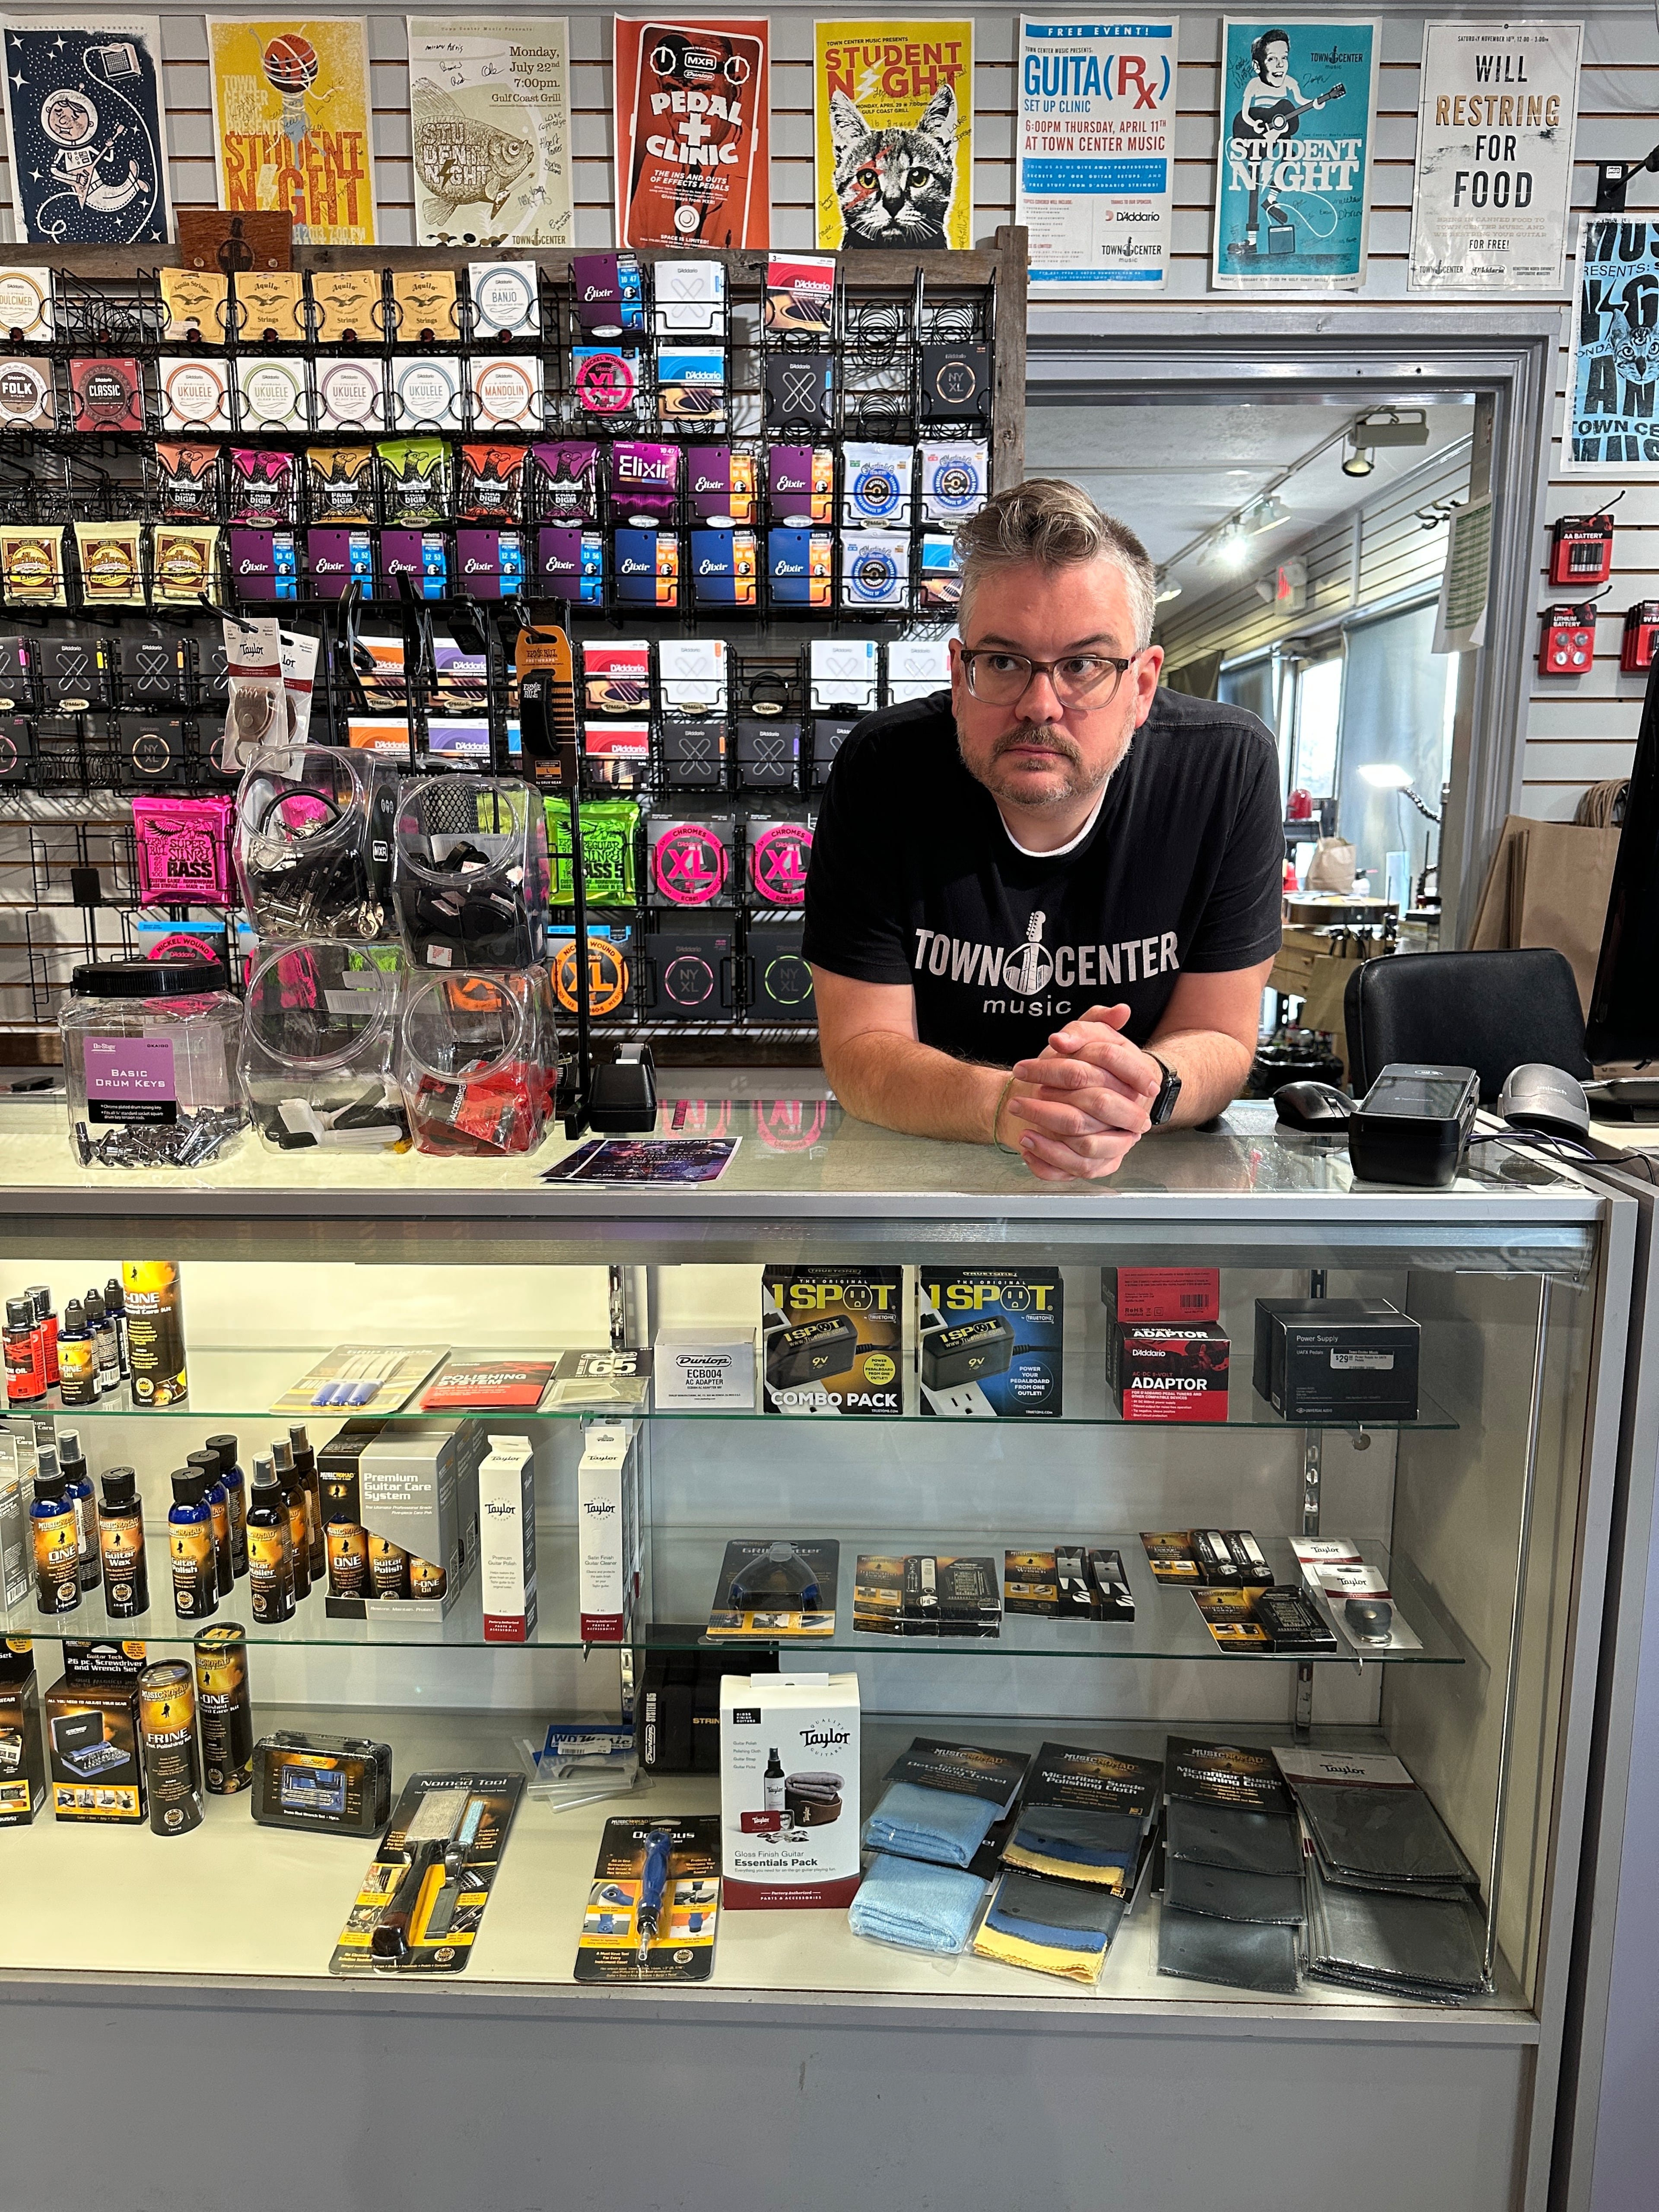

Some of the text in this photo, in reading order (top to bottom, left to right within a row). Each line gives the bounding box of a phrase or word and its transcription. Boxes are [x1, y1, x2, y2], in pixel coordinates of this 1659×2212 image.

[509, 46, 559, 59] Monday,
[825, 42, 962, 70] STUDENT
[510, 61, 560, 74] July 22nd
[687, 56, 714, 67] MXR
[1475, 55, 1528, 83] WILL
[222, 75, 257, 90] TOWN
[514, 78, 560, 90] 7:00pm.
[650, 91, 743, 126] PEDAL
[1025, 99, 1090, 112] SET UP CLINIC
[1435, 95, 1560, 127] RESTRING
[227, 119, 285, 136] PRESENTS
[1026, 120, 1166, 134] 6:00PM THURSDAY, APRIL 11TH
[422, 123, 465, 144] STU
[1025, 136, 1165, 151] AT TOWN CENTER MUSIC
[1474, 134, 1516, 162] FOR
[225, 131, 364, 179] STUDENT
[423, 145, 481, 165] DENT
[646, 135, 739, 165] CLINIC
[1229, 137, 1362, 163] STUDENT
[661, 177, 697, 188] EFFECTS
[699, 182, 730, 192] PEDALS
[686, 173, 704, 181] AND
[705, 175, 727, 184] OUTS
[1453, 171, 1532, 207] FOOD
[1116, 211, 1159, 221] D'Addario
[512, 235, 566, 245] TOWN CENTER
[1469, 240, 1510, 249] FOR FREE!
[1102, 245, 1161, 255] TOWN CENTER
[794, 280, 830, 290] D'Addario
[492, 292, 517, 303] BANJO
[584, 286, 613, 301] Elixir
[685, 371, 722, 380] D'Addario
[948, 372, 964, 382] NY
[2, 382, 32, 394] FOLK
[89, 384, 121, 397] CLASSIC
[178, 387, 212, 397] UKULELE
[333, 387, 367, 397] UKULELE
[409, 387, 443, 397] UKULELE
[485, 386, 524, 396] MANDOLIN
[948, 383, 964, 392] XL
[619, 455, 669, 479] Elixir
[776, 476, 806, 491] Elixir
[175, 495, 196, 503] DIGM
[240, 559, 267, 573] Elixir
[315, 558, 344, 572] Elixir
[621, 559, 650, 573] Elixir
[775, 561, 803, 576] Elixir
[240, 644, 264, 656] Taylor
[610, 664, 646, 673] D'Addario
[611, 745, 646, 753] D'Addario
[671, 828, 707, 839] CHROMES
[169, 839, 206, 849] SUPER
[169, 849, 210, 862] SLINKY
[167, 863, 213, 877] BASS
[666, 849, 714, 879] XL
[915, 928, 1179, 987] TOWN CENTER
[679, 969, 699, 980] NY
[680, 982, 699, 992] XL
[983, 995, 1071, 1017] music
[1536, 1084, 1567, 1096] unitech
[1317, 1335, 1339, 1343] Supply
[1132, 1349, 1166, 1357] D'Addario
[588, 1357, 636, 1374] 65
[687, 1370, 722, 1379] ECB004
[1131, 1378, 1208, 1390] ADAPTOR
[771, 1392, 897, 1407] COMBO PACK
[363, 1473, 418, 1482] Premium
[364, 1482, 432, 1491] Guitar Care
[365, 1491, 410, 1500] System
[484, 1503, 516, 1516] Taylor
[584, 1502, 615, 1514] Taylor
[48, 1545, 76, 1561] ONE
[105, 1550, 135, 1559] Guitar
[109, 1558, 131, 1567] Wax
[333, 1556, 361, 1568] ONE
[373, 1558, 402, 1567] Guitar
[373, 1564, 403, 1573] Polish
[1337, 1577, 1367, 1587] Taylor
[147, 1728, 188, 1744] FRINE
[799, 1728, 850, 1748] Taylor
[1320, 1763, 1367, 1777] Taylor
[735, 1858, 818, 1867] Essentials Pack
